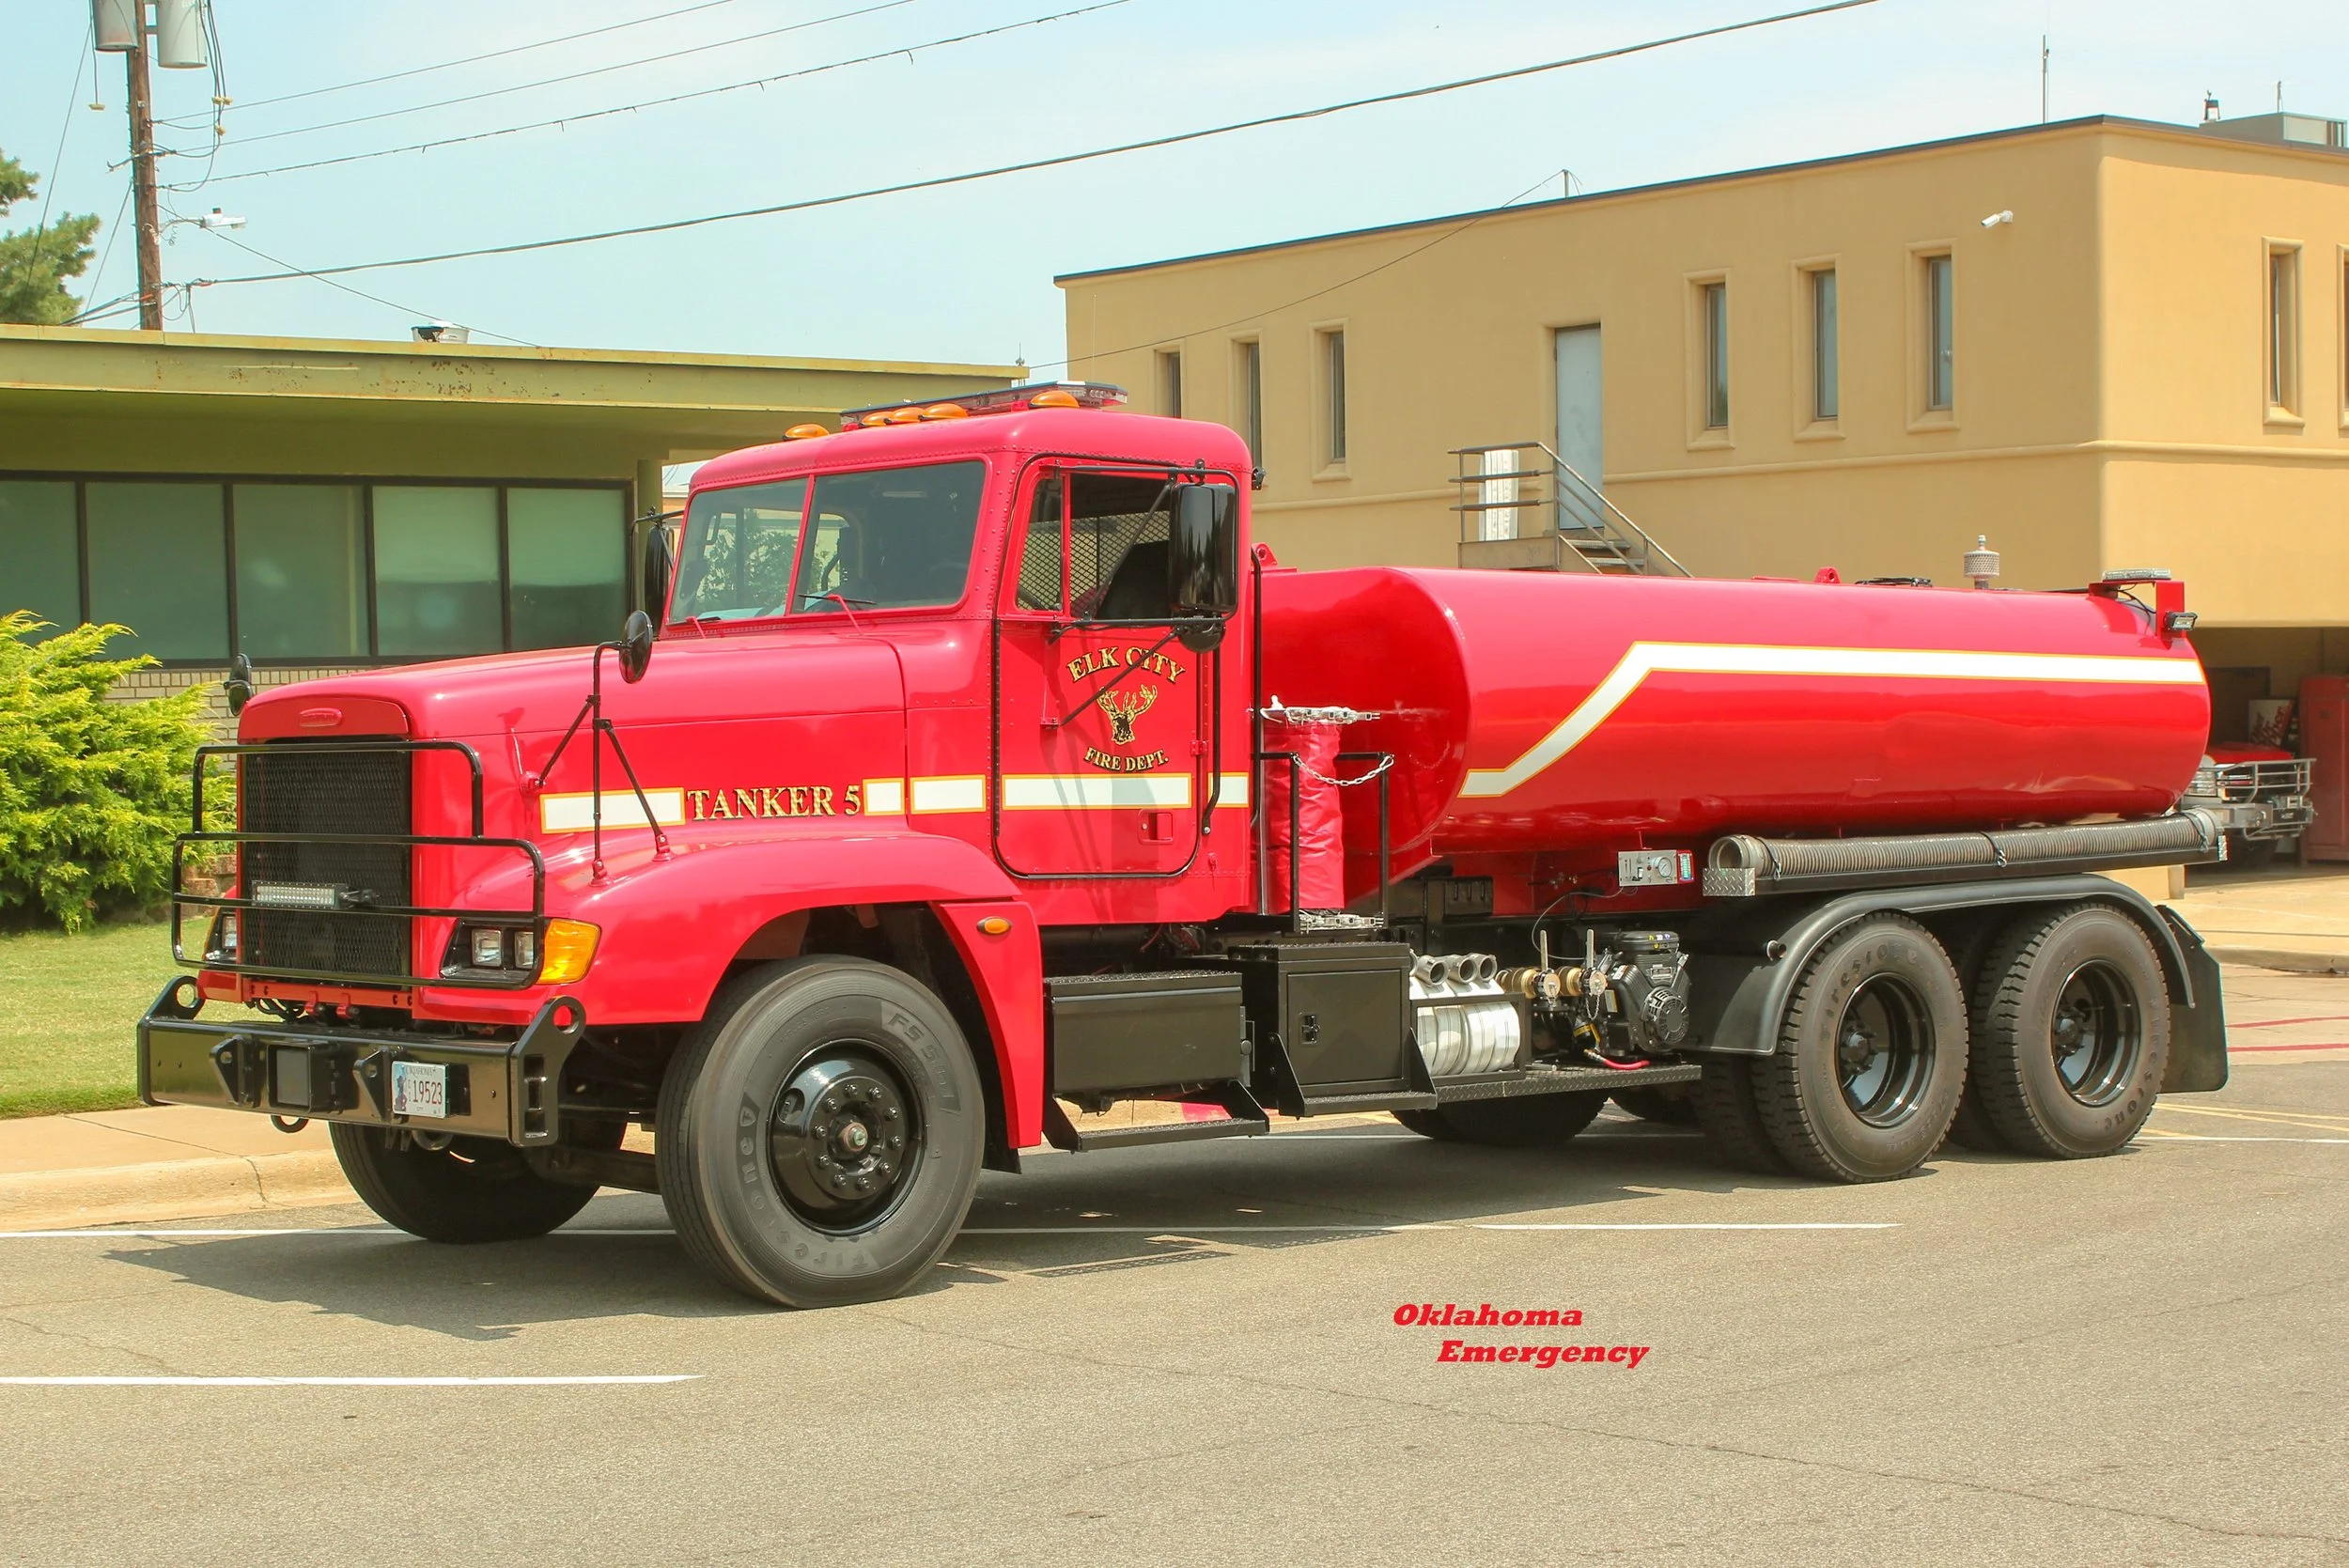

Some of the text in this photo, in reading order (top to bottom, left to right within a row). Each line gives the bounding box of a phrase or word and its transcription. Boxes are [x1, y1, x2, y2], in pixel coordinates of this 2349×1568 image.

[1066, 646, 1186, 684] ELK CITY
[1083, 747, 1170, 772] FIRE DEPT.
[687, 784, 862, 822] TANKER 5
[887, 1013, 926, 1043] FS
[412, 1079, 443, 1106] 19523
